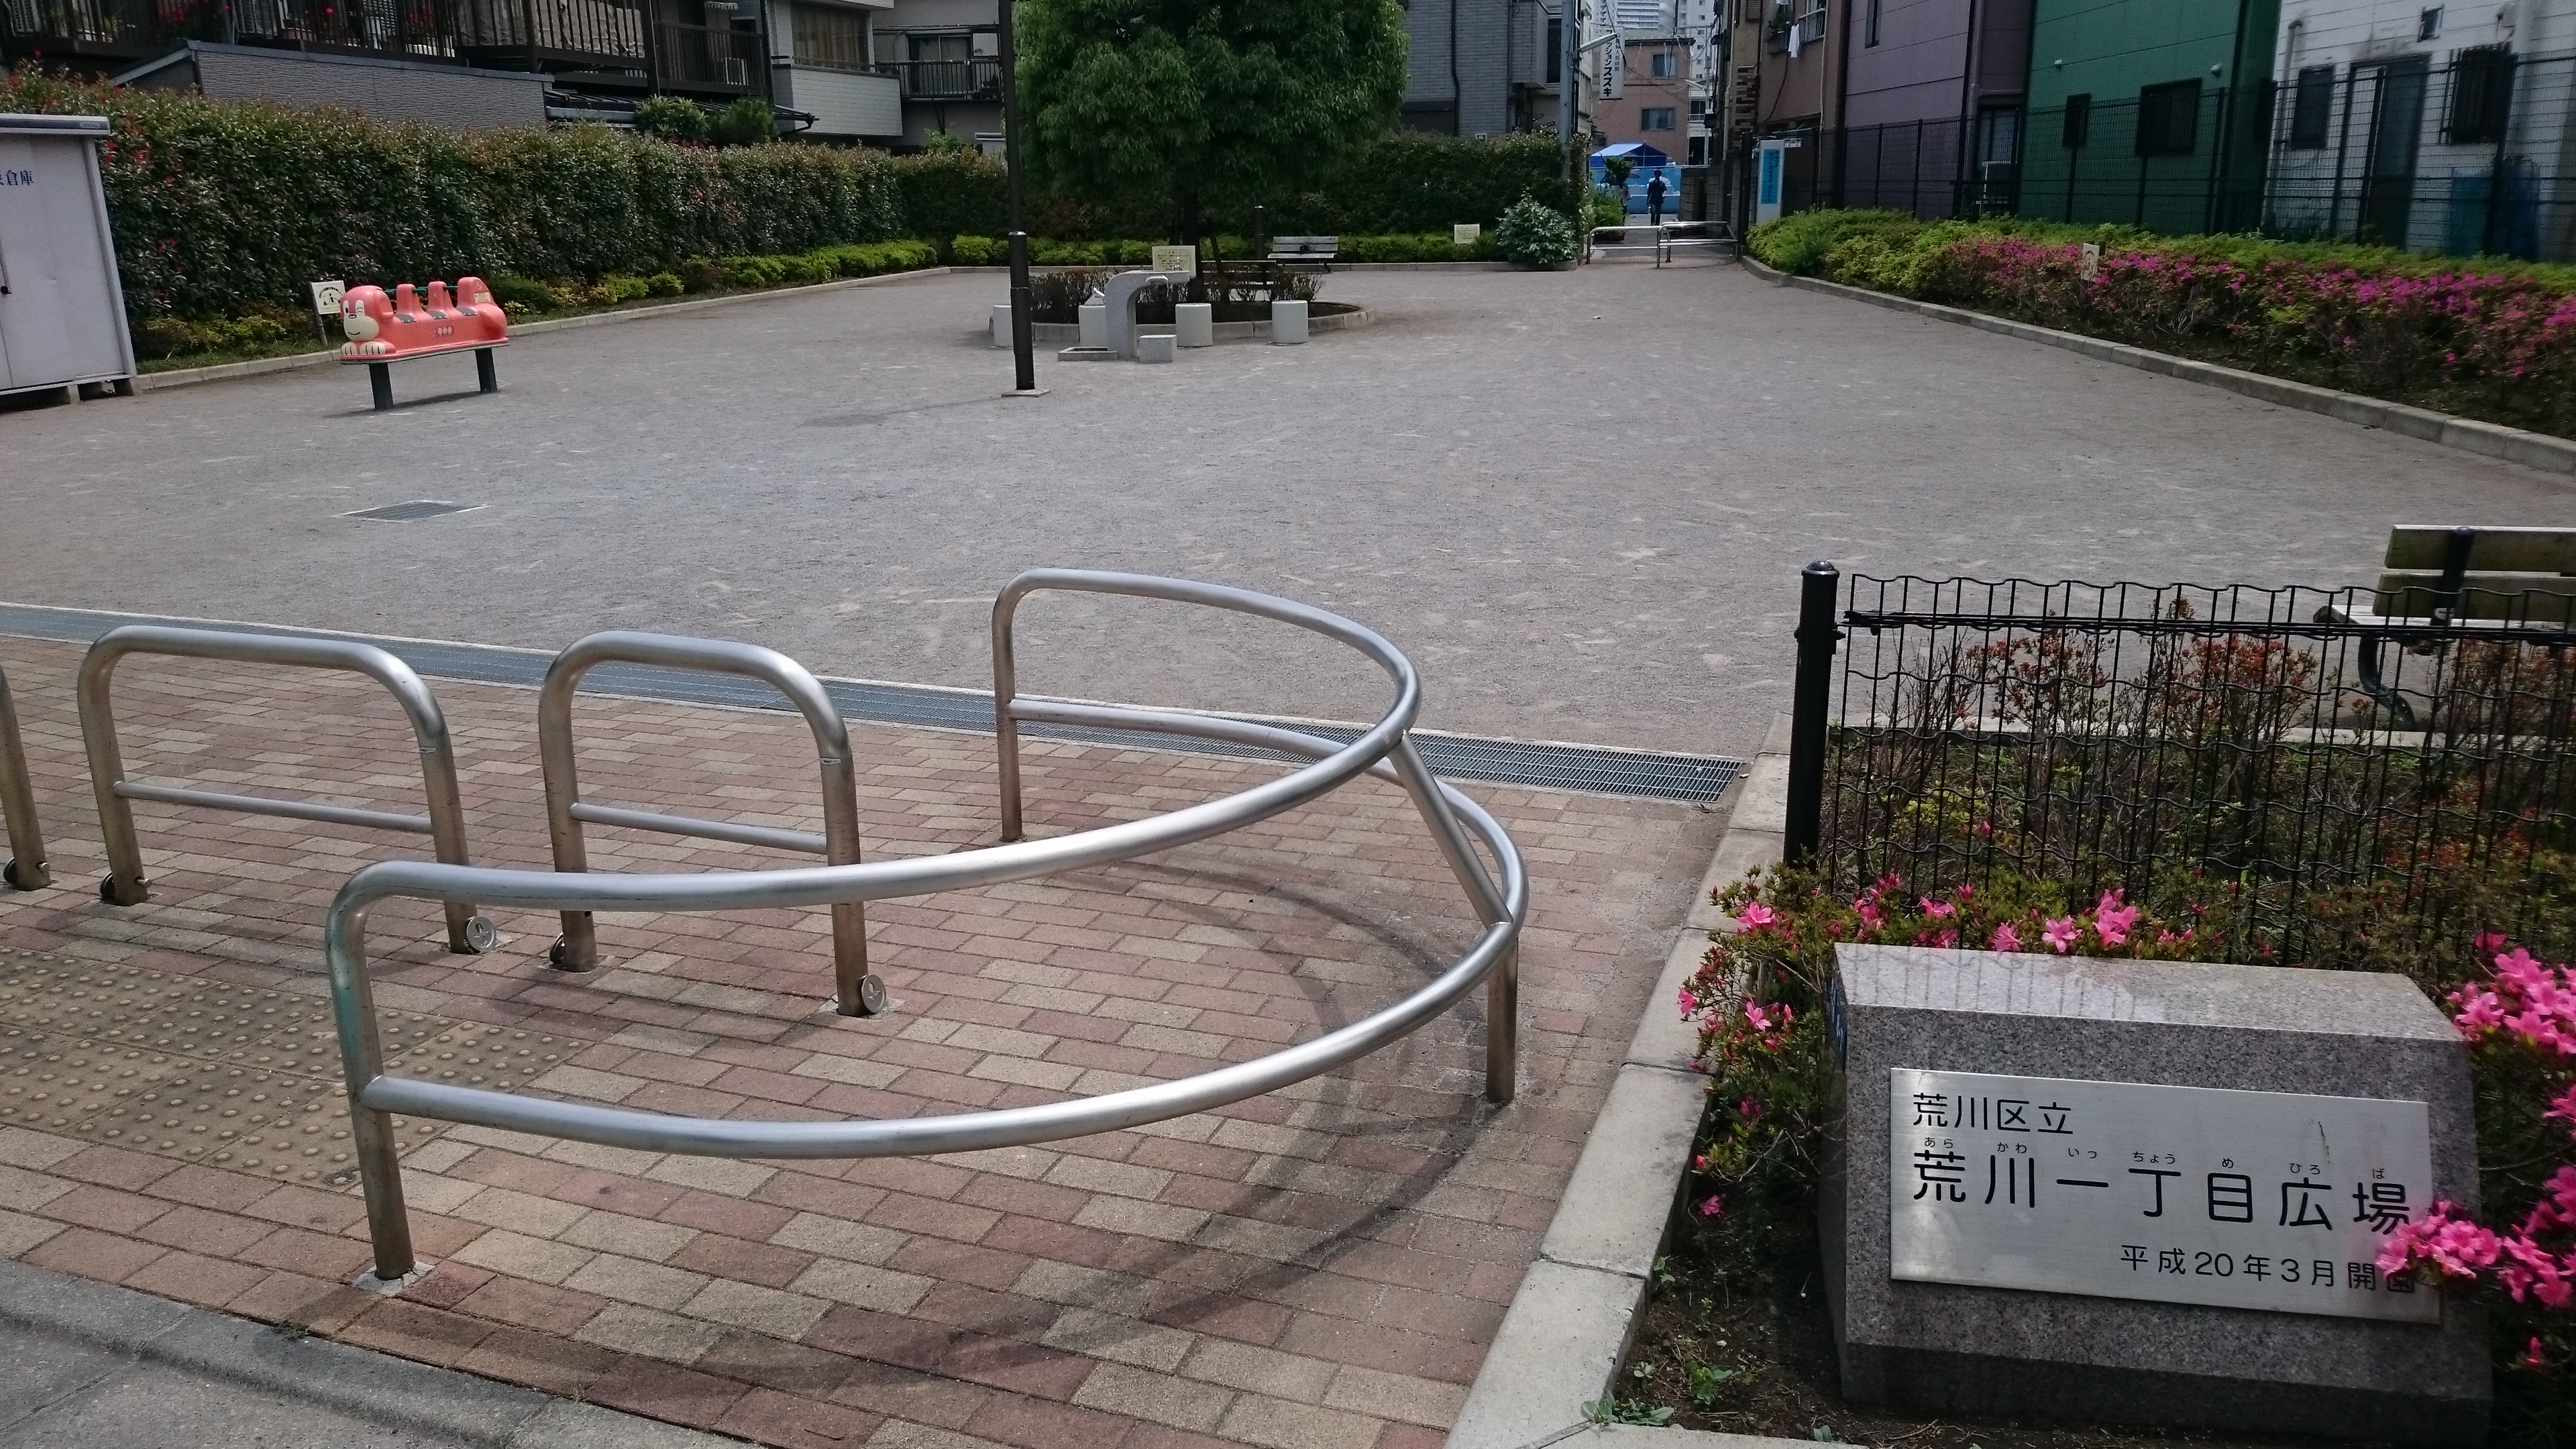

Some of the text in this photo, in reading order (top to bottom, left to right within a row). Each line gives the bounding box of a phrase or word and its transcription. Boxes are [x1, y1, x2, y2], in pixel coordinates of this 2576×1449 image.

[1603, 30, 1613, 97] フッションスズキ
[0, 169, 34, 186] 倉庫
[1913, 1092, 2074, 1134] 荒川区立
[1925, 1136, 1953, 1149] あら
[1997, 1141, 2027, 1153] かわ
[2132, 1150, 2176, 1165] ちょう
[2221, 1157, 2234, 1169] め
[2289, 1163, 2321, 1175] ひろ
[2372, 1168, 2385, 1180] ば
[1913, 1149, 2410, 1235] 荒川一丁目広場
